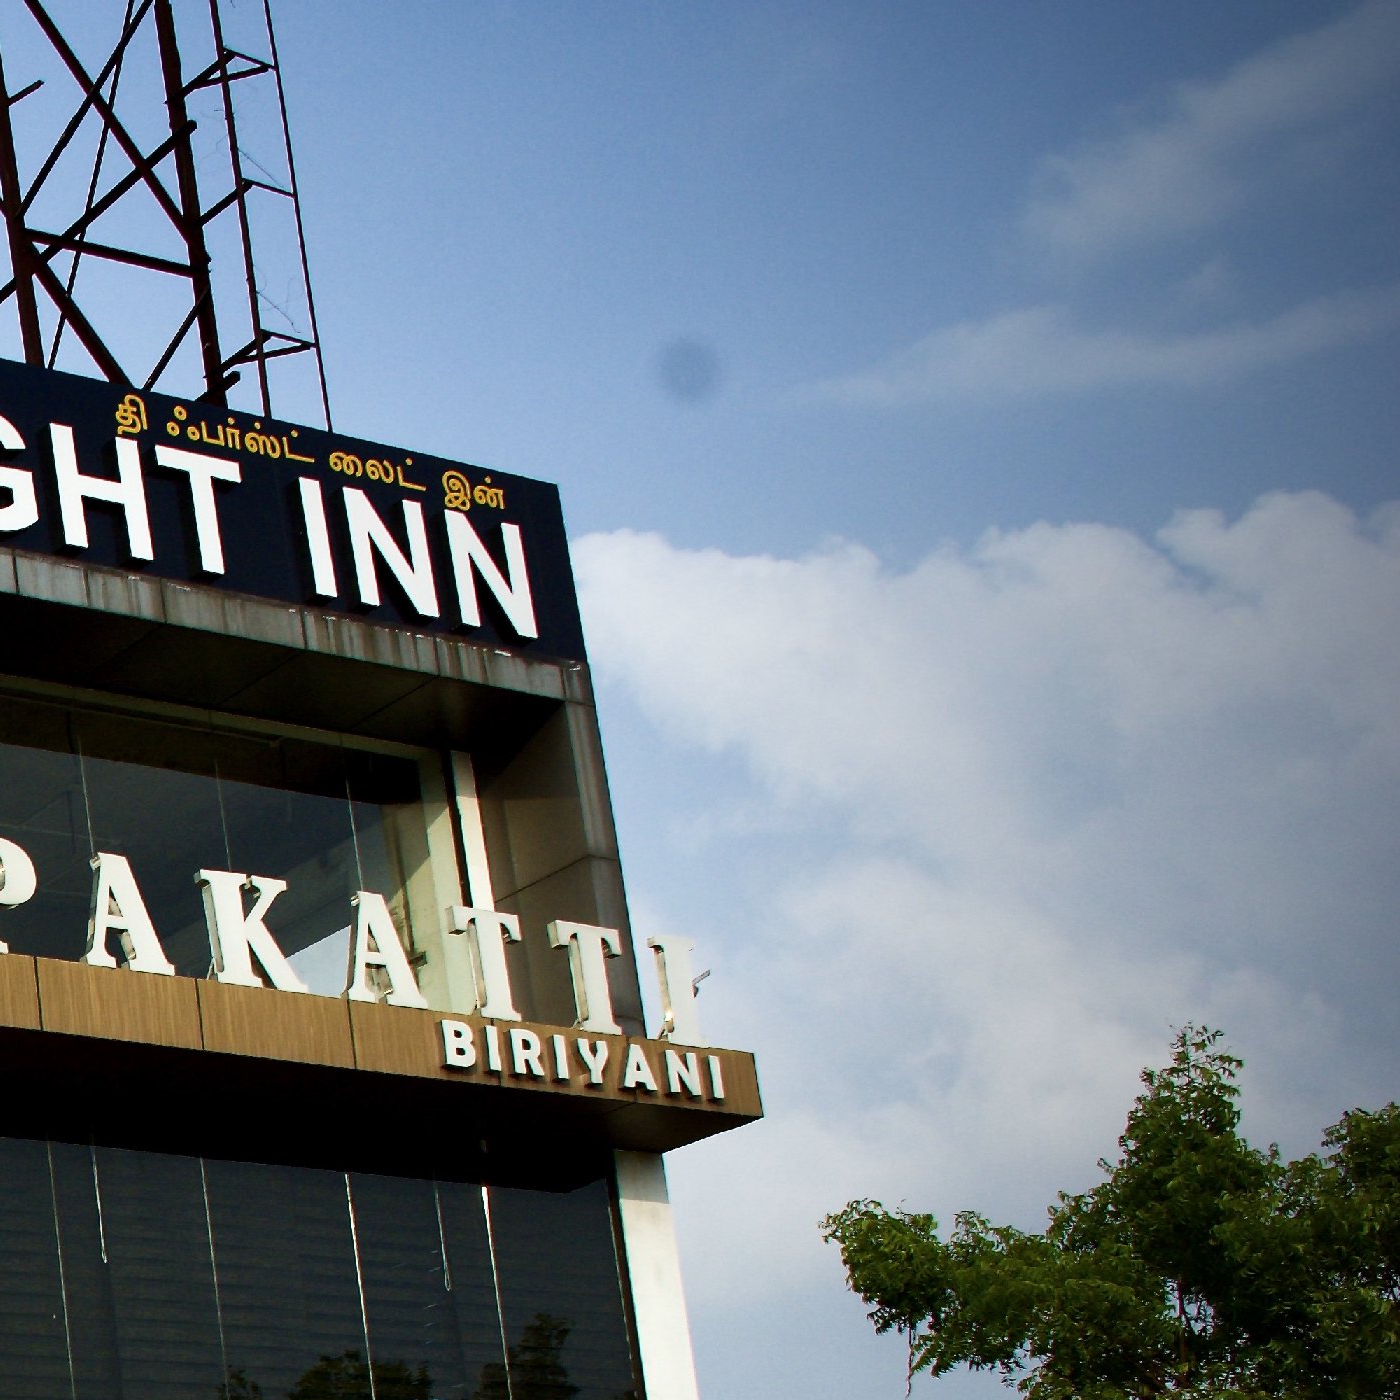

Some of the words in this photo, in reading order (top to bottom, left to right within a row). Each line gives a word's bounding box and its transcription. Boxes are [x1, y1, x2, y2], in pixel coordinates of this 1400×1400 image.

[115, 394, 148, 434] தி
[329, 451, 426, 491] லைட்
[441, 470, 505, 511] இன்
[297, 476, 539, 640] INN
[439, 1019, 726, 1101] BIRIYANI
